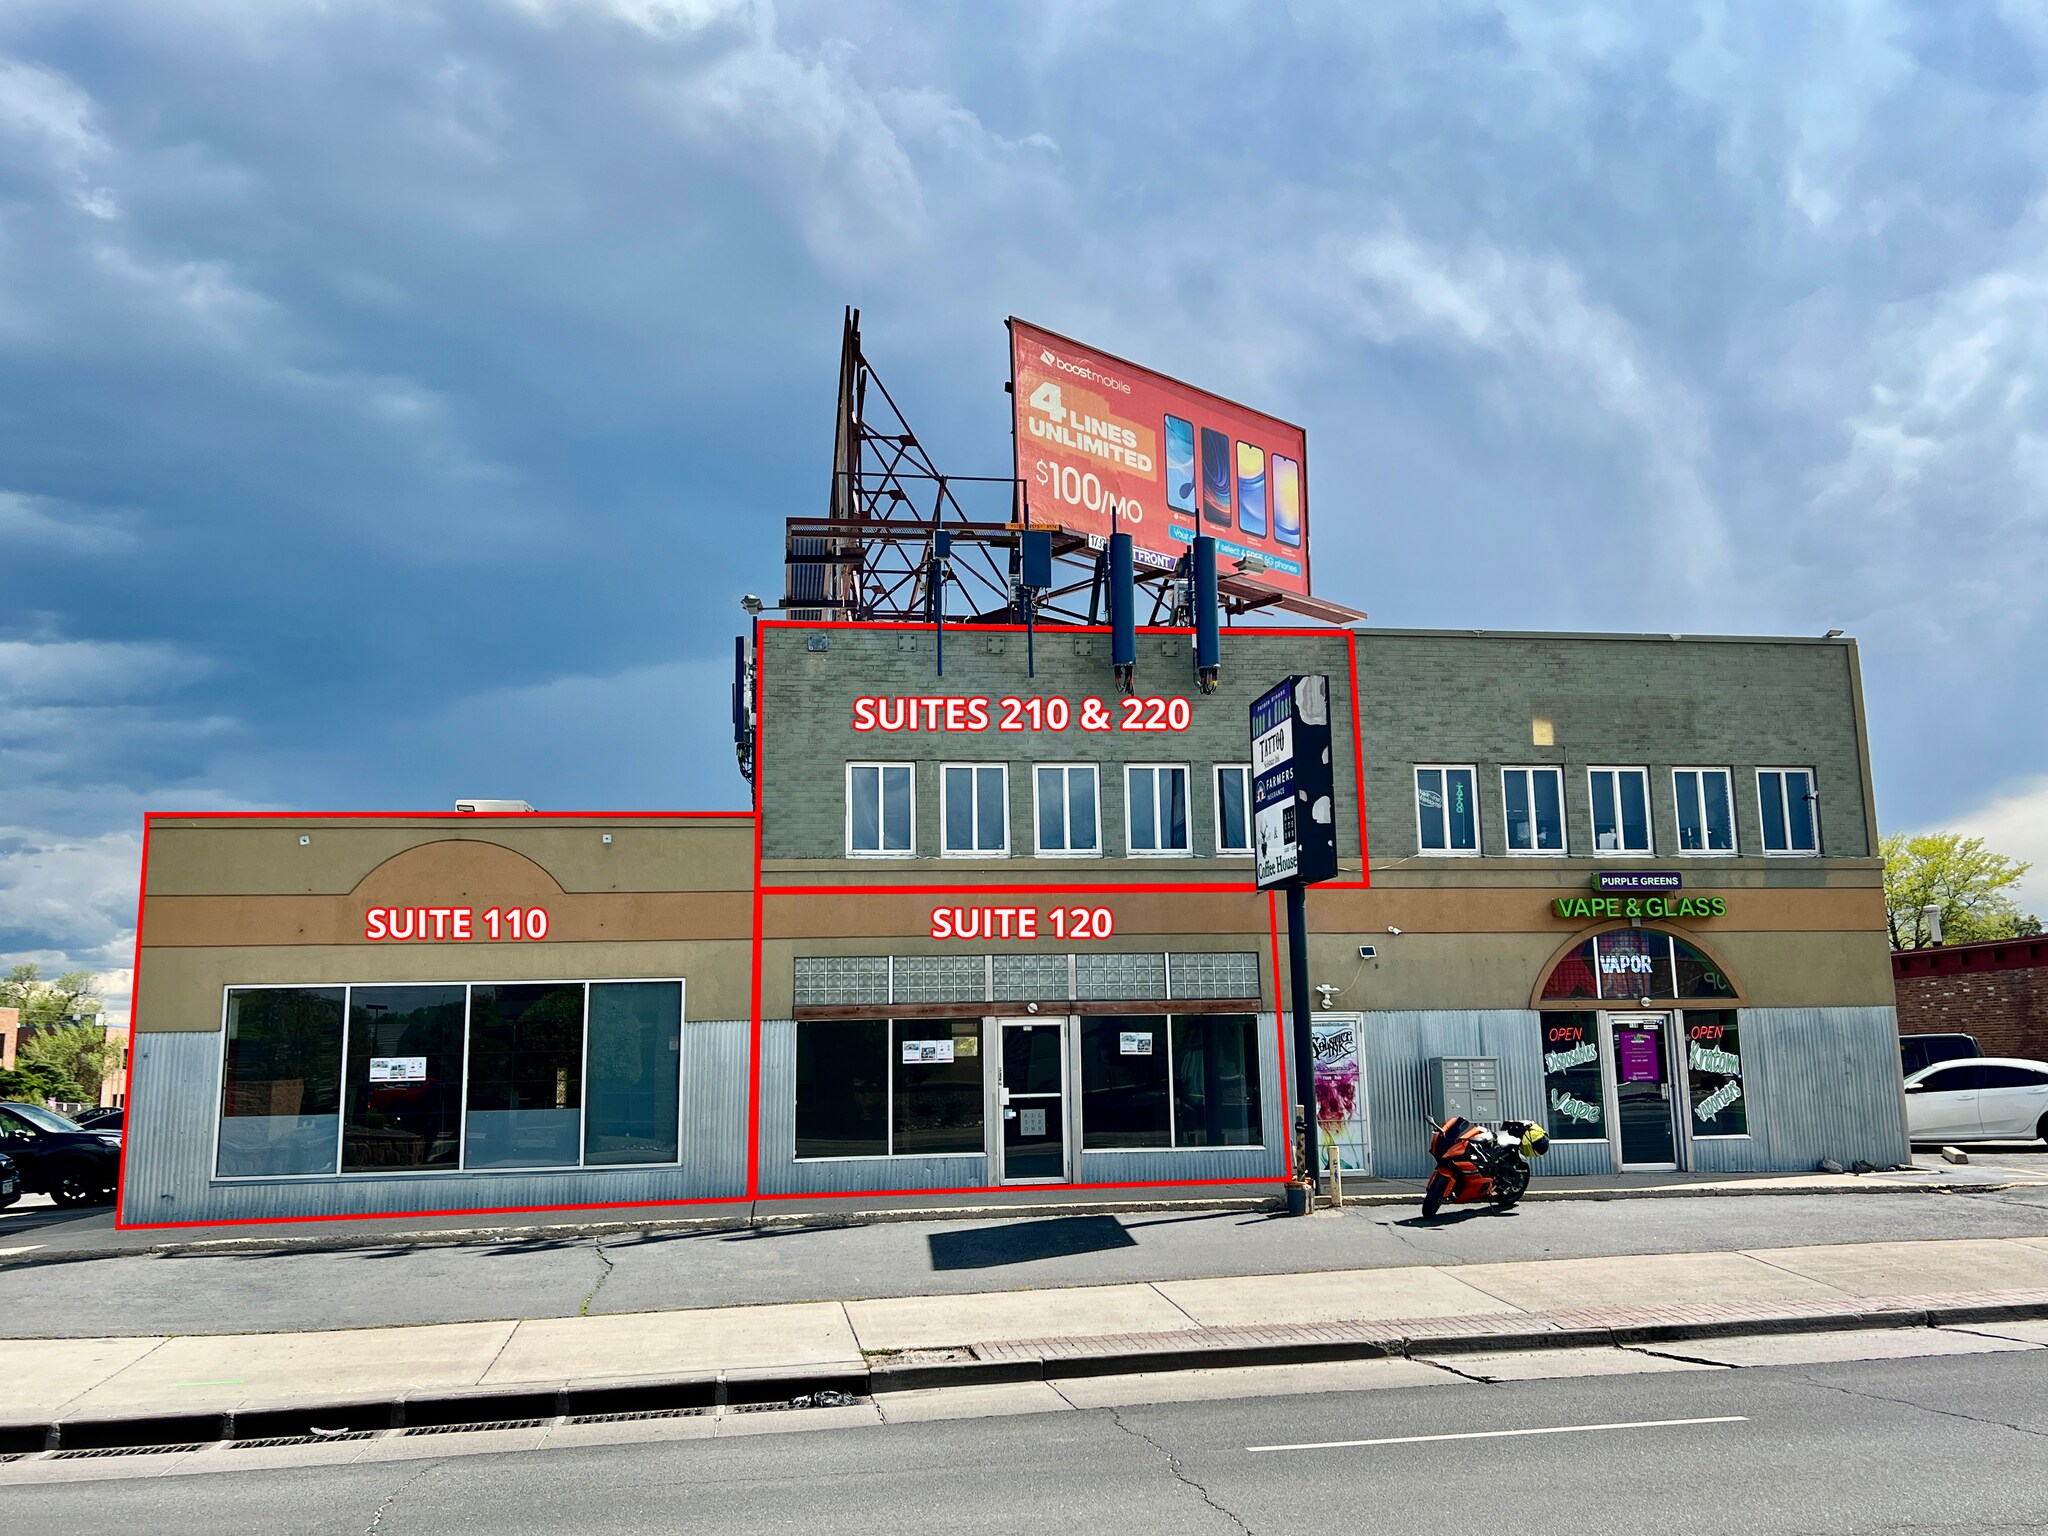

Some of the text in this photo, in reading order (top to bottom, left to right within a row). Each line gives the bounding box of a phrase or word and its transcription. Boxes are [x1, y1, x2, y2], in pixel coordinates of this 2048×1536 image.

[1028, 380, 1138, 449] 4 LINES
[1028, 415, 1153, 473] UNLIMITED
[1035, 457, 1144, 525] $100/MO
[1220, 544, 1240, 556] select
[1275, 560, 1297, 574] phones
[1265, 766, 1294, 791] FARMERS
[1258, 855, 1298, 879] Coffee House
[1601, 876, 1679, 887] PURPLE GREENS
[1558, 897, 1727, 917] VAPE & GLASS
[1600, 954, 1653, 974] VAPOR
[1549, 1027, 1583, 1042] OPEN
[1691, 1026, 1724, 1040] OPEN
[1545, 1040, 1598, 1075] Disposables
[1689, 1040, 1740, 1075] Kratom
[1551, 1088, 1600, 1125] Vape
